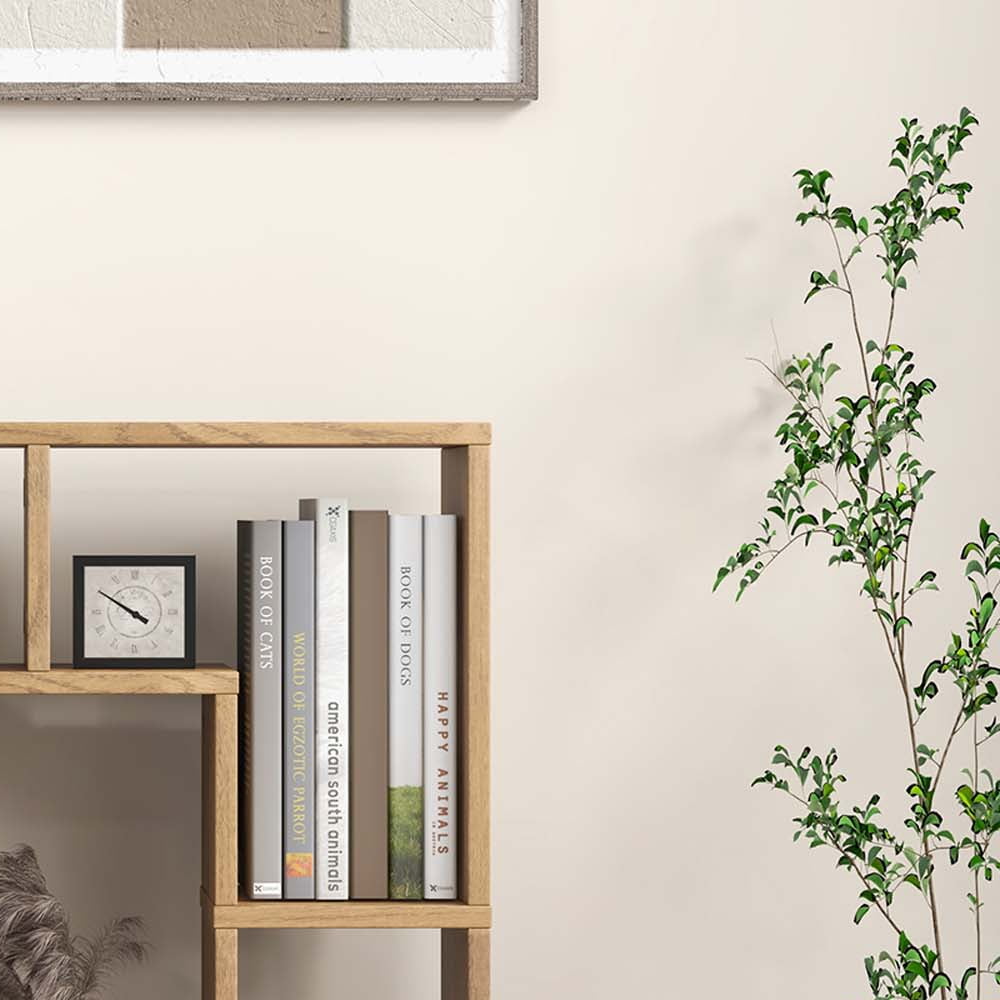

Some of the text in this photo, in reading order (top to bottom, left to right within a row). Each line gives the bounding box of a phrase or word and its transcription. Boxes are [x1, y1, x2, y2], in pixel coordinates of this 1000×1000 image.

[259, 556, 273, 669] BOOK OF CATS
[400, 566, 412, 686] BOOK OF DOGS
[292, 631, 306, 845] WORLD OF EGZOTIC PARROT
[327, 701, 343, 893] american south animals
[437, 691, 449, 855] HAPPY ANIMALS
